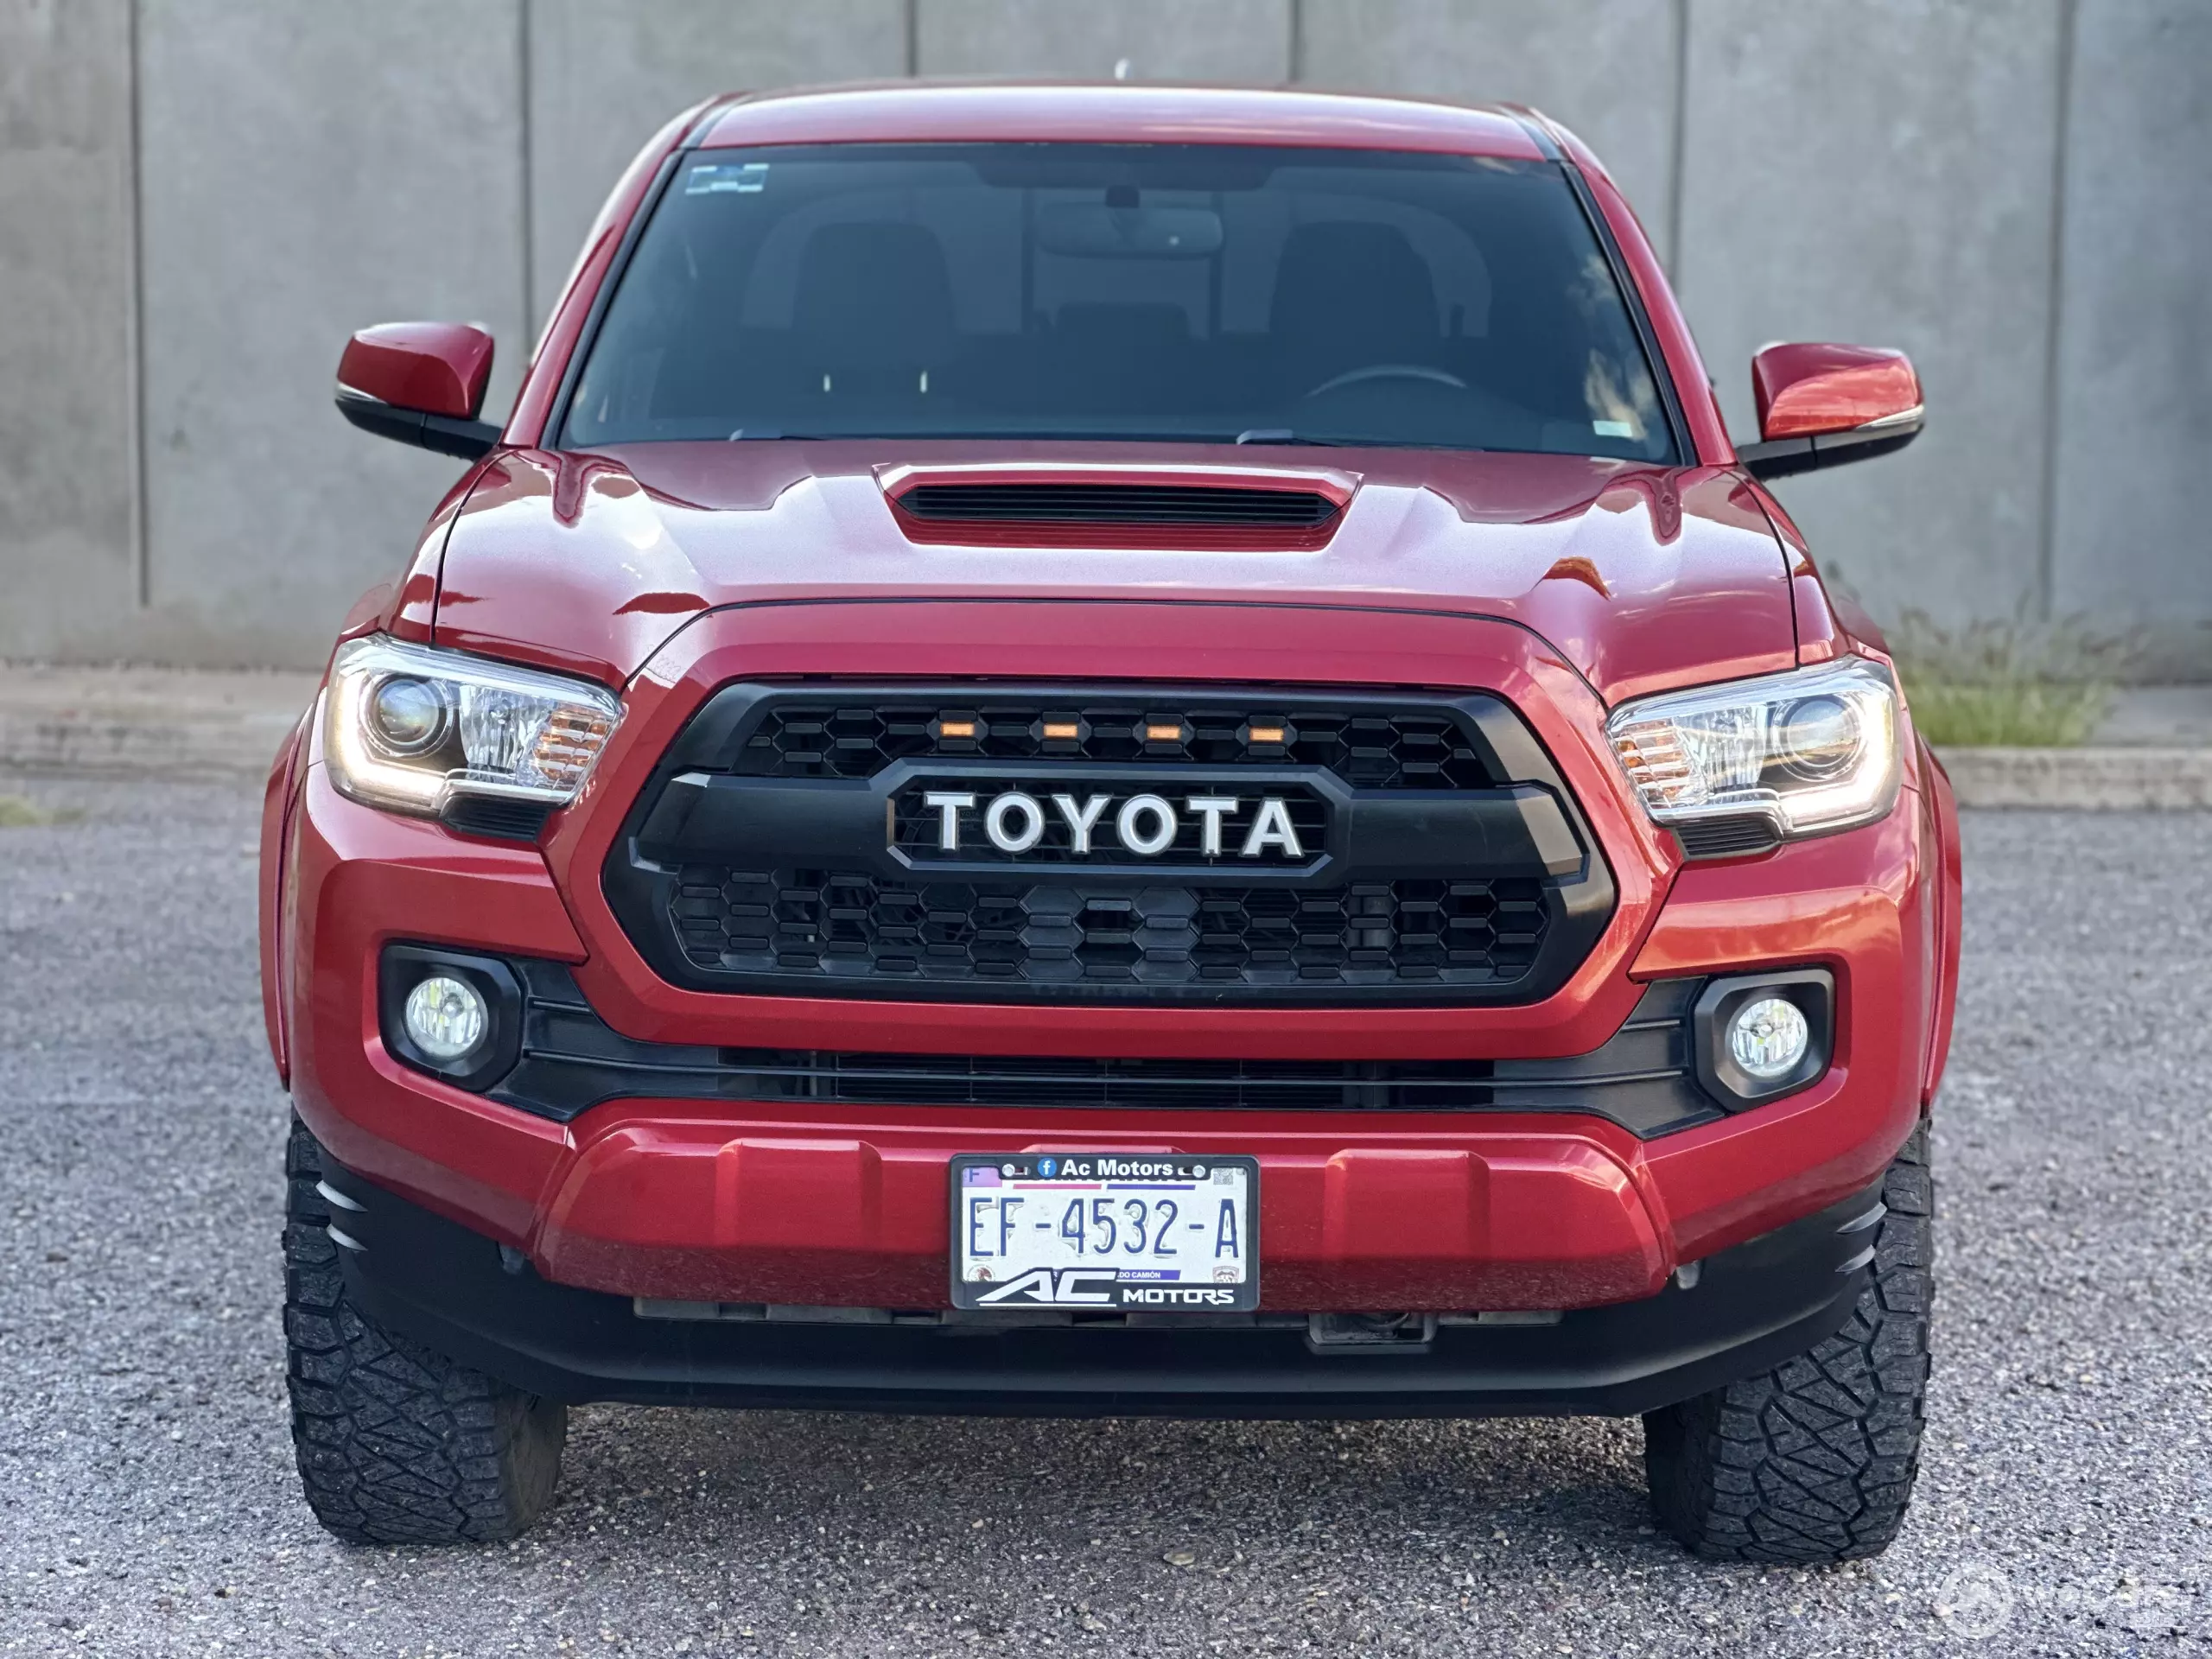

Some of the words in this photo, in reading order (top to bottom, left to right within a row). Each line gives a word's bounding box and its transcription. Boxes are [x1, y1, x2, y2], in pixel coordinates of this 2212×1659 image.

[924, 791, 1305, 858] TOYOTA
[1061, 1159, 1090, 1176] Ac
[1097, 1159, 1173, 1176] Motors
[976, 1270, 1116, 1302] AC
[1122, 1288, 1235, 1306] MOTORS
